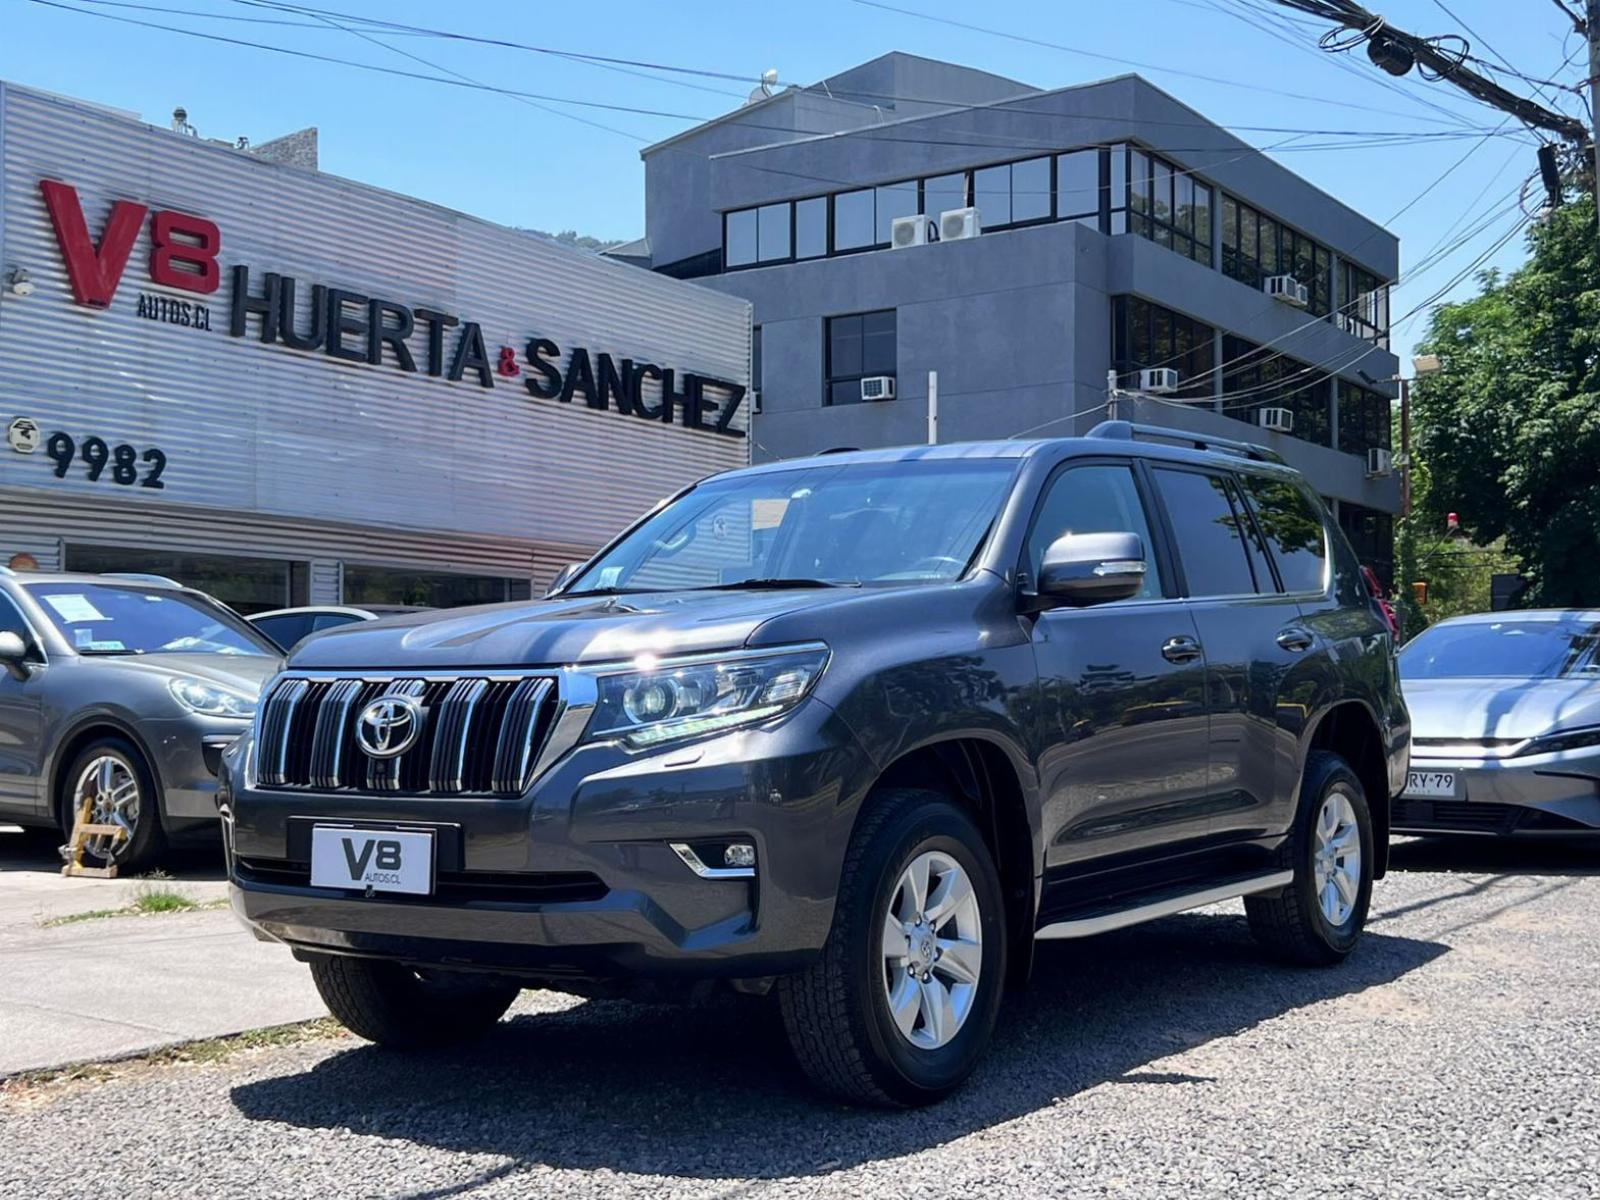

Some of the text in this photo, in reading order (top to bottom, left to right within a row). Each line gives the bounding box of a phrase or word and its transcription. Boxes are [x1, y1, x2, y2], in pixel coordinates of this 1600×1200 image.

[40, 179, 221, 309] V8
[137, 295, 213, 332] AUTOS.CL
[230, 264, 746, 437] HUERTA & SANCHEZ
[48, 431, 167, 488] 9982
[342, 838, 402, 881] V8
[365, 873, 401, 885] AUTOS.CL
